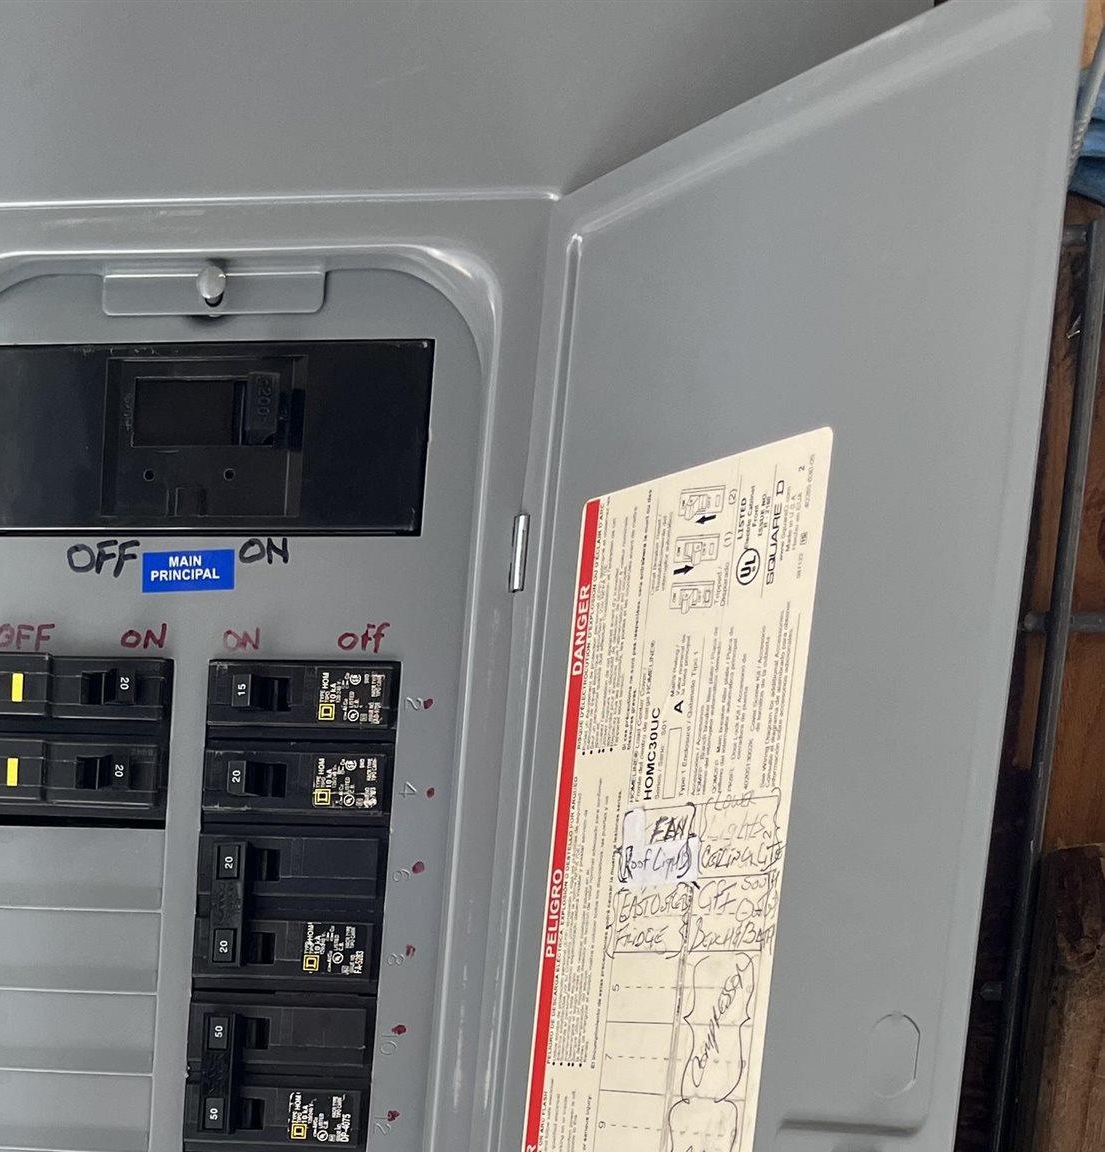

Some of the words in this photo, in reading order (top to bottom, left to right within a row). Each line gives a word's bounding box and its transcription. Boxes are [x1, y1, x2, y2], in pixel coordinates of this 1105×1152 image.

[737, 496, 747, 540] LISTED
[751, 503, 759, 527] Front
[765, 502, 782, 585] SQUARE
[775, 478, 784, 496] D
[67, 539, 140, 576] OFF
[239, 537, 289, 564] ON
[169, 555, 202, 567] MAIN
[740, 554, 756, 578] UL
[150, 567, 220, 581] PRINCIPAL
[121, 623, 167, 648] ON
[572, 582, 590, 676] DANGER
[223, 627, 261, 649] ON
[120, 677, 130, 690] 20
[322, 672, 330, 690] HOM
[237, 683, 246, 695] 15
[404, 697, 422, 709] 2
[673, 699, 683, 714] A
[643, 706, 660, 800] HOMC30UC
[115, 765, 124, 778] 20
[232, 770, 241, 783] 20
[400, 781, 416, 797] 4
[224, 857, 233, 868] 20
[393, 870, 410, 883] 6
[545, 867, 563, 958] PELIGRO
[219, 940, 228, 953] 20
[388, 954, 404, 966] 8
[215, 1025, 224, 1038] 50
[380, 1035, 397, 1055] 10
[209, 1107, 218, 1120] 50
